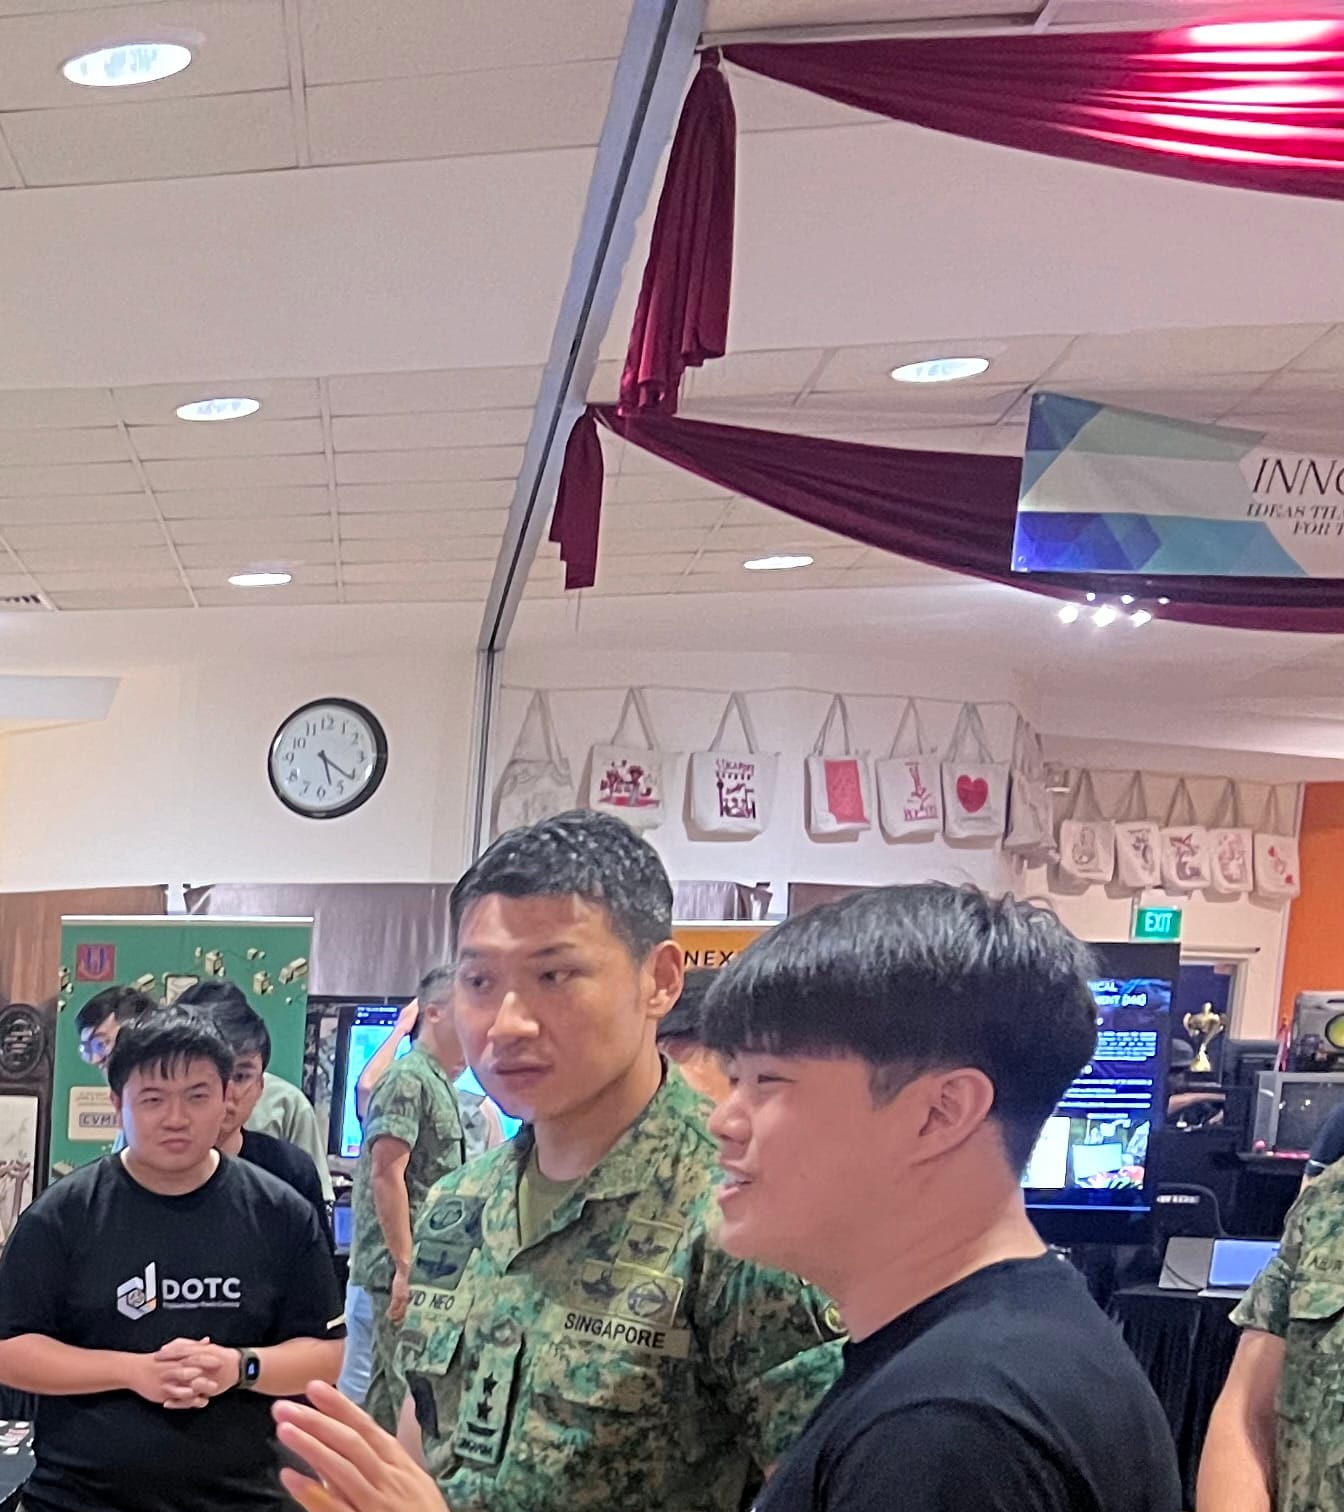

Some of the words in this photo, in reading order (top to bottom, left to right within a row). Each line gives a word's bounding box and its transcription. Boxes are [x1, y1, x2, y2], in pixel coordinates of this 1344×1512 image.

[1253, 457, 1344, 496] INN
[1310, 505, 1344, 519] TH
[1294, 521, 1330, 536] FOR
[1145, 912, 1172, 933] EXIT
[162, 1277, 241, 1300] DOTC
[429, 1293, 456, 1310] NEO
[564, 1313, 666, 1349] SINGAPORE
